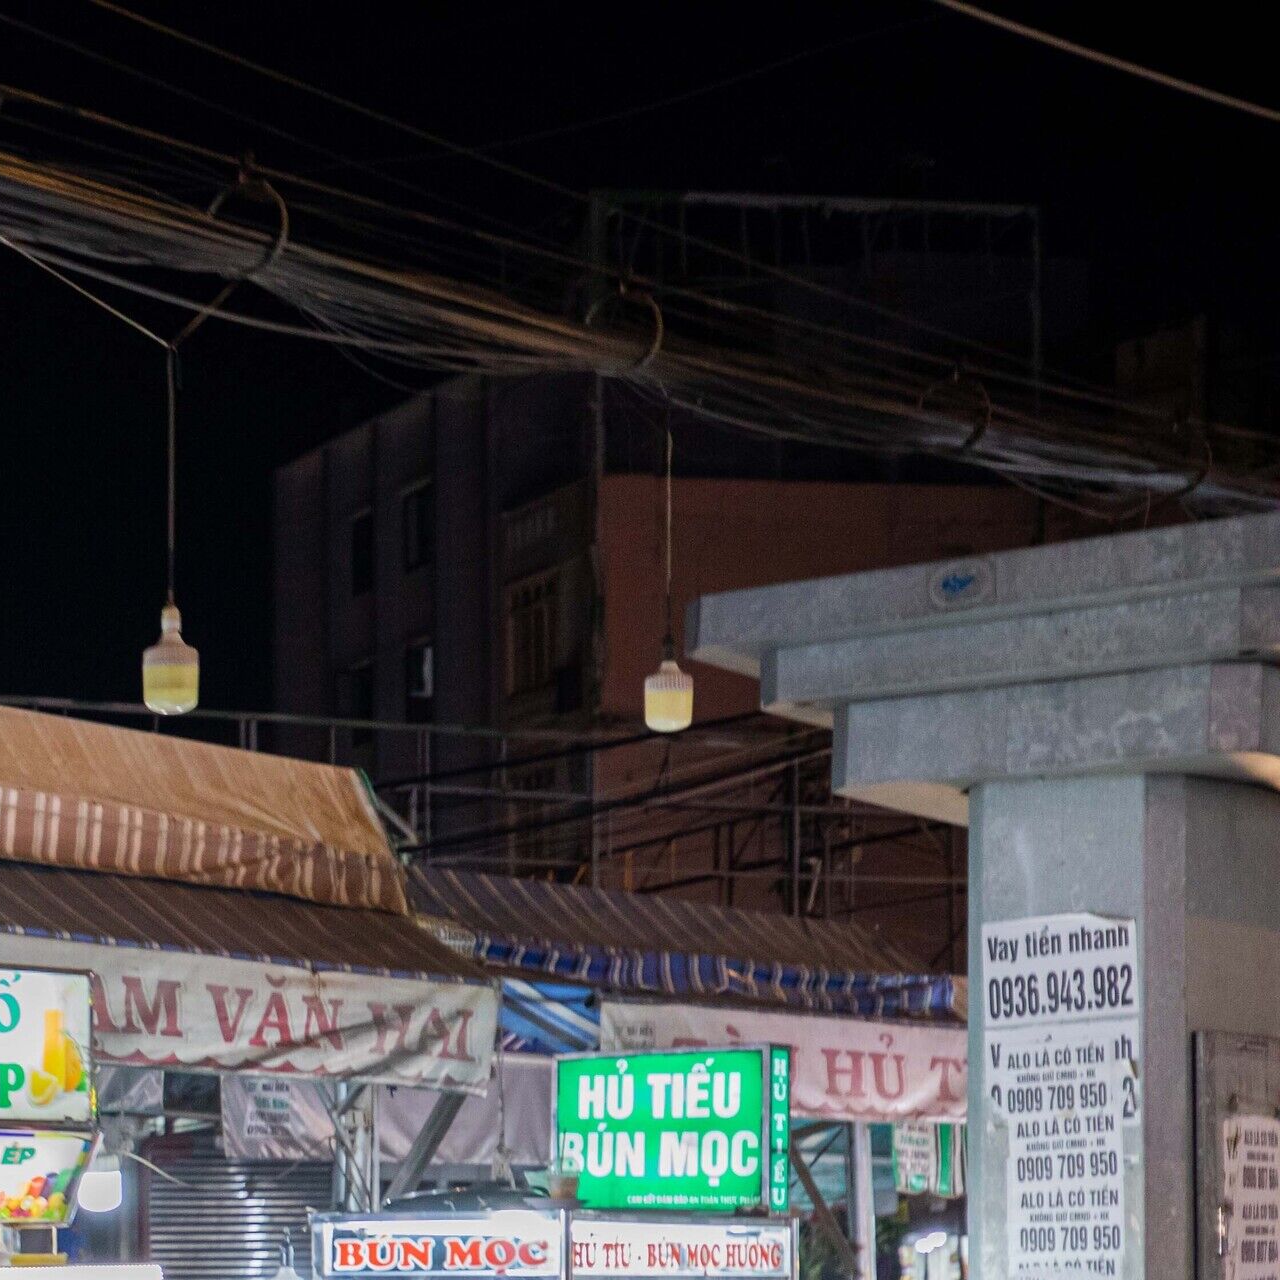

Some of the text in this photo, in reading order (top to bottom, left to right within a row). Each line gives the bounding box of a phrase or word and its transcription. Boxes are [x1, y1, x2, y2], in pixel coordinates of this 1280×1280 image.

[987, 936, 1019, 963] Vay
[1068, 925, 1130, 953] nhanh
[989, 964, 1134, 1019] 0936.943.982
[206, 974, 345, 1051] VĂN
[368, 1002, 476, 1063] HAI
[578, 1058, 635, 1120] HỦ
[647, 1056, 742, 1120] TIẾU
[821, 1032, 907, 1100] HỦ
[1007, 1087, 1043, 1114] 0909
[1048, 1084, 1075, 1110] 709
[1080, 1082, 1107, 1108] 950
[0, 1140, 37, 1166] ÉP
[560, 1122, 760, 1187] BÚN MỌC
[1017, 1150, 1118, 1182] 0909 709 950
[333, 1229, 550, 1276] BÚN MỌC
[647, 1236, 681, 1269] BÚN
[686, 1243, 721, 1277] MỌC
[1020, 1224, 1121, 1252] 0909 709 950
